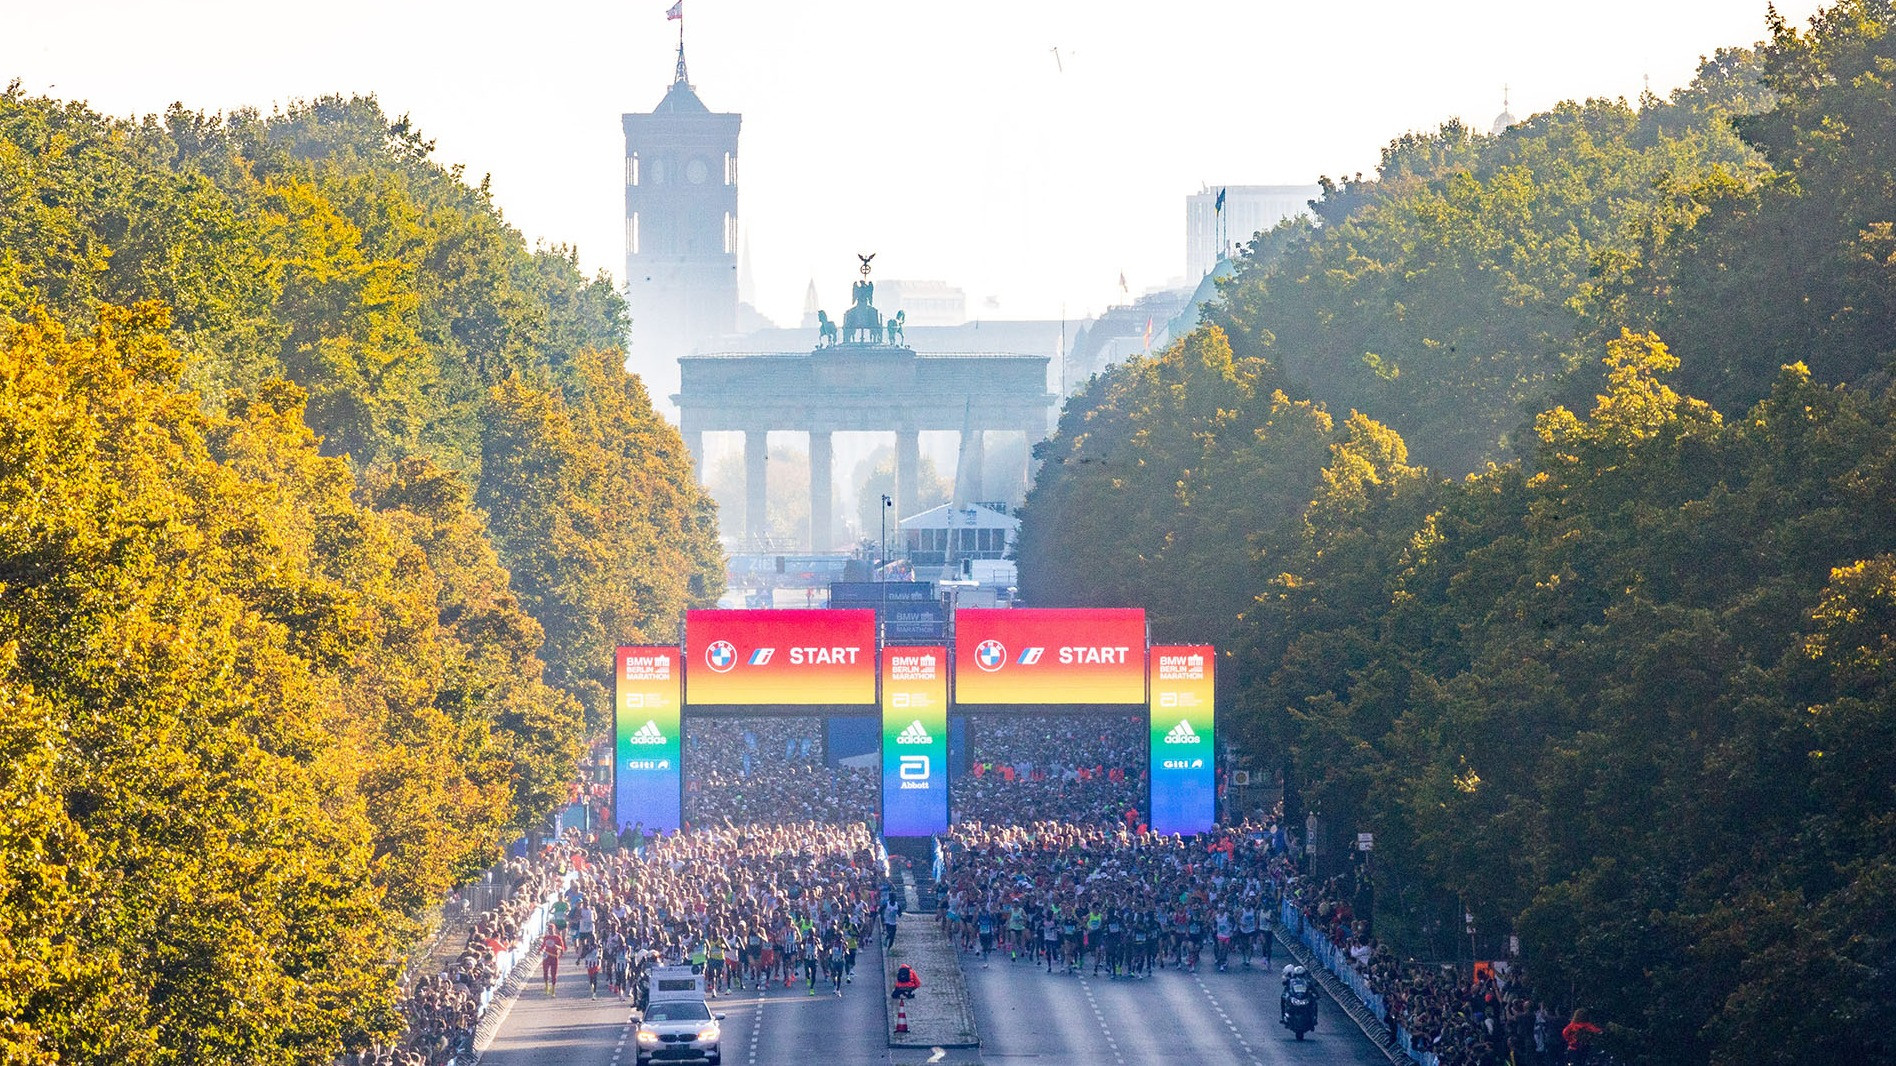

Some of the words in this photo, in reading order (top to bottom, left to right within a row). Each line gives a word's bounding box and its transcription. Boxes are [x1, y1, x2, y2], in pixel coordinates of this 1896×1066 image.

[897, 612, 919, 621] BMW
[789, 647, 860, 664] START
[1059, 646, 1129, 664] START
[626, 657, 653, 667] BMW
[892, 656, 919, 666] BMW
[1160, 656, 1187, 666] BMW
[630, 734, 667, 745] adidas
[896, 735, 933, 745] adidas
[1164, 734, 1201, 744] adidas
[900, 781, 930, 790] Abbott
